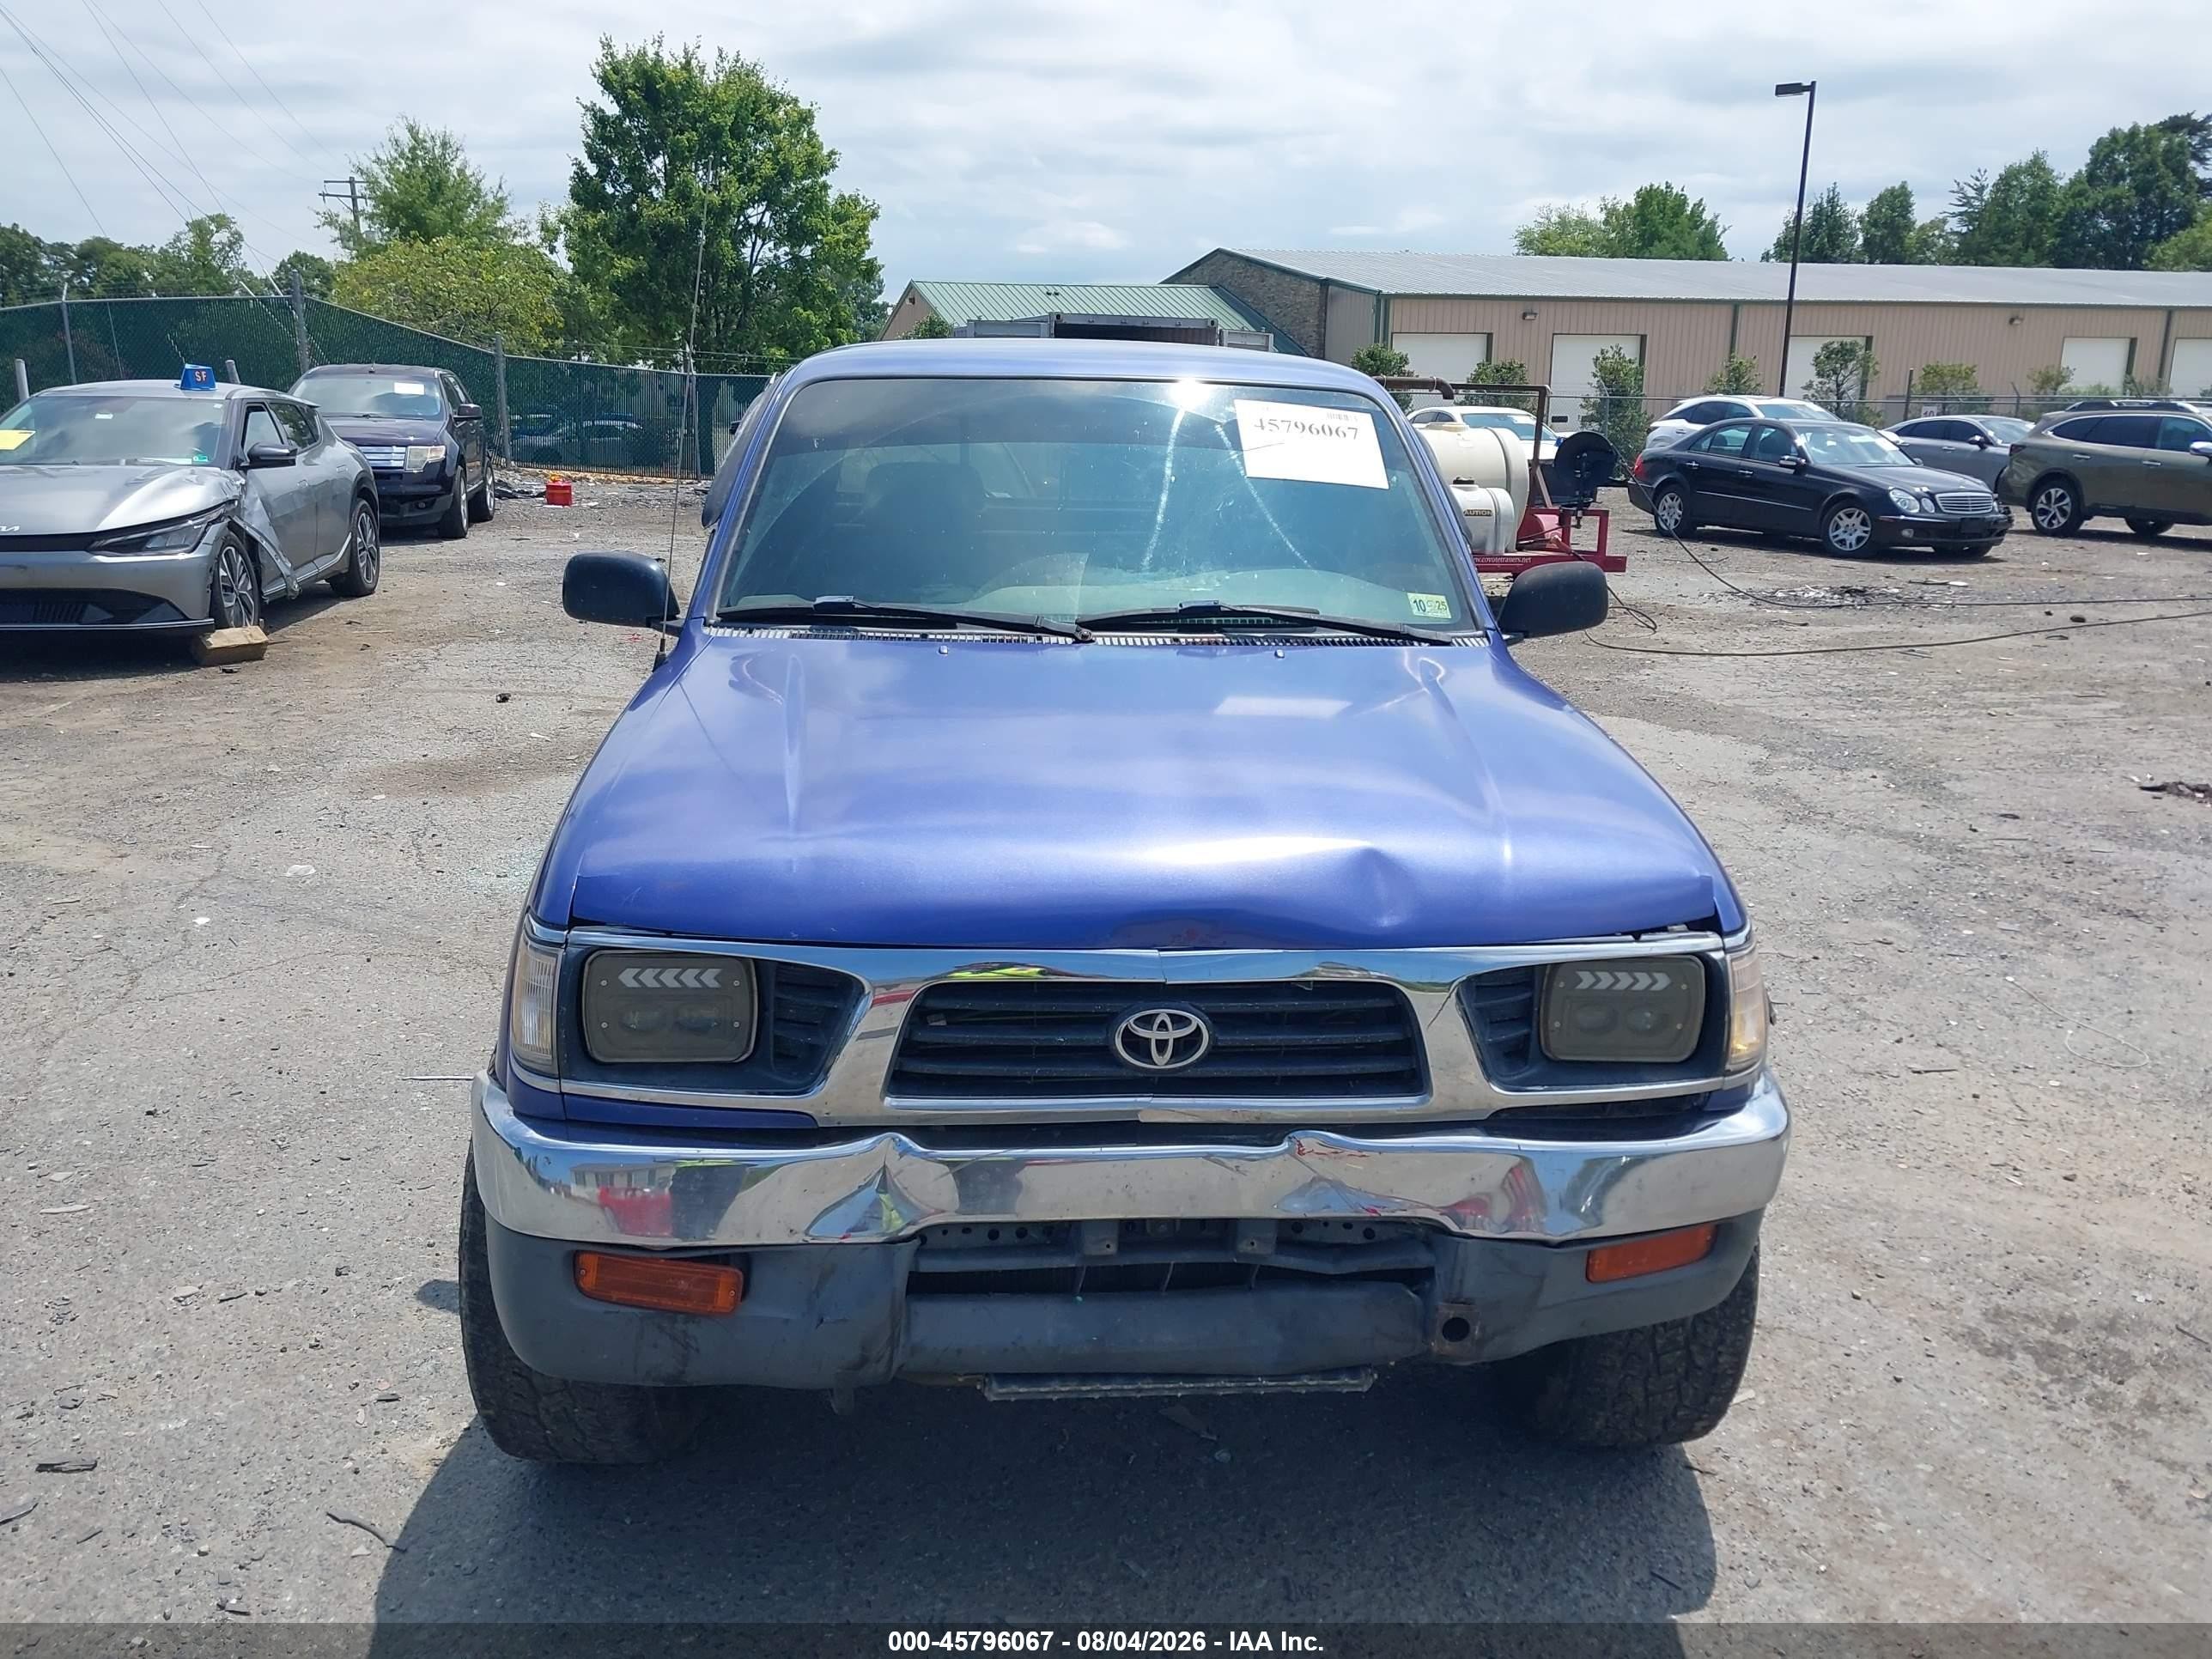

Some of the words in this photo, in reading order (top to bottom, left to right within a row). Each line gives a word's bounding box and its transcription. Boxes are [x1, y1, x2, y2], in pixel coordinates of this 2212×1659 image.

[1254, 418, 1358, 440] 45796067
[1413, 599, 1426, 612] 10
[1436, 600, 1447, 611] 25
